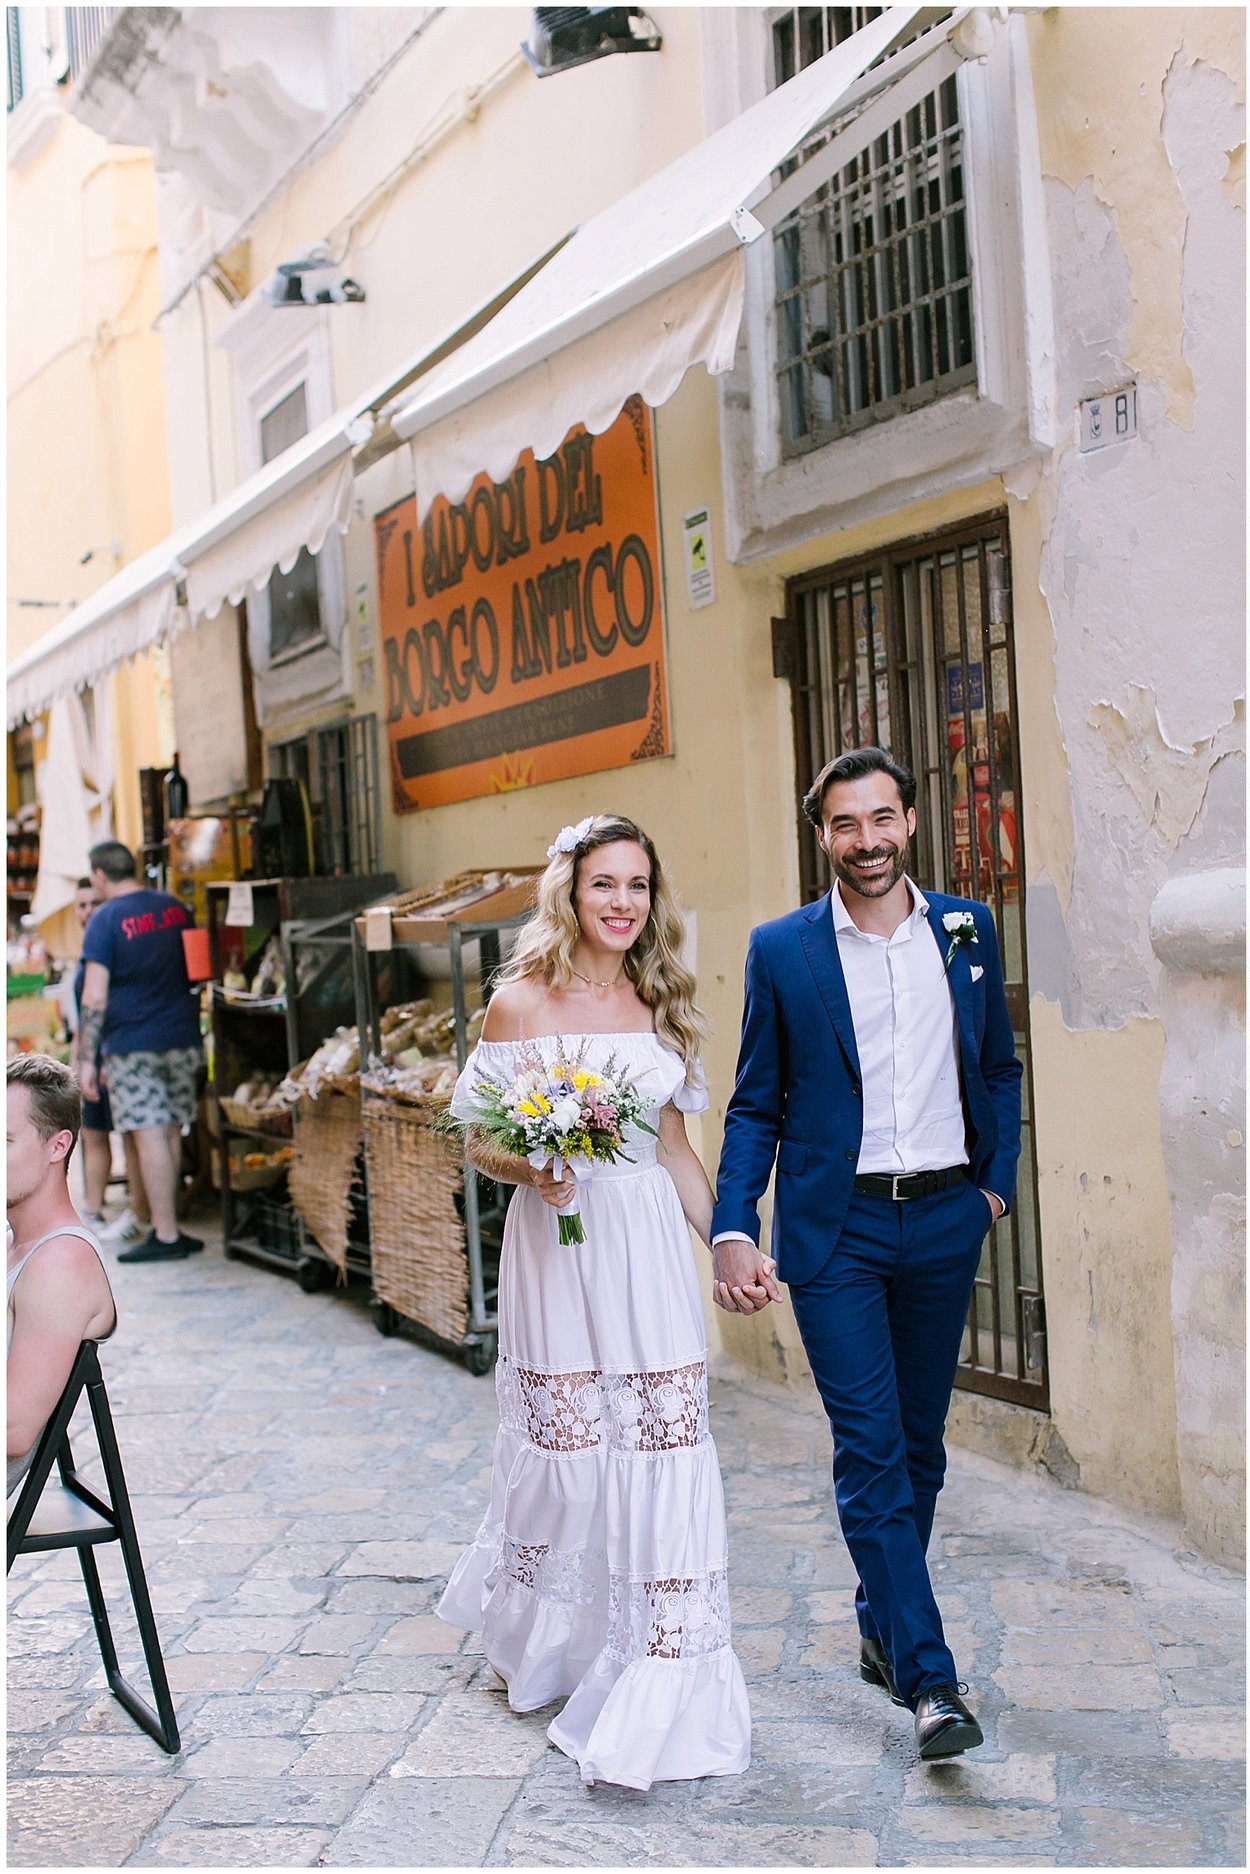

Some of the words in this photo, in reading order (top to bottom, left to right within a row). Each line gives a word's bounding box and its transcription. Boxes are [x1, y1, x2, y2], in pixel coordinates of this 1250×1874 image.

[403, 530, 416, 607] I
[422, 466, 531, 598] SAPORI
[534, 432, 603, 544] DEL
[384, 597, 499, 722] BORGO
[510, 533, 655, 687] ANTICO
